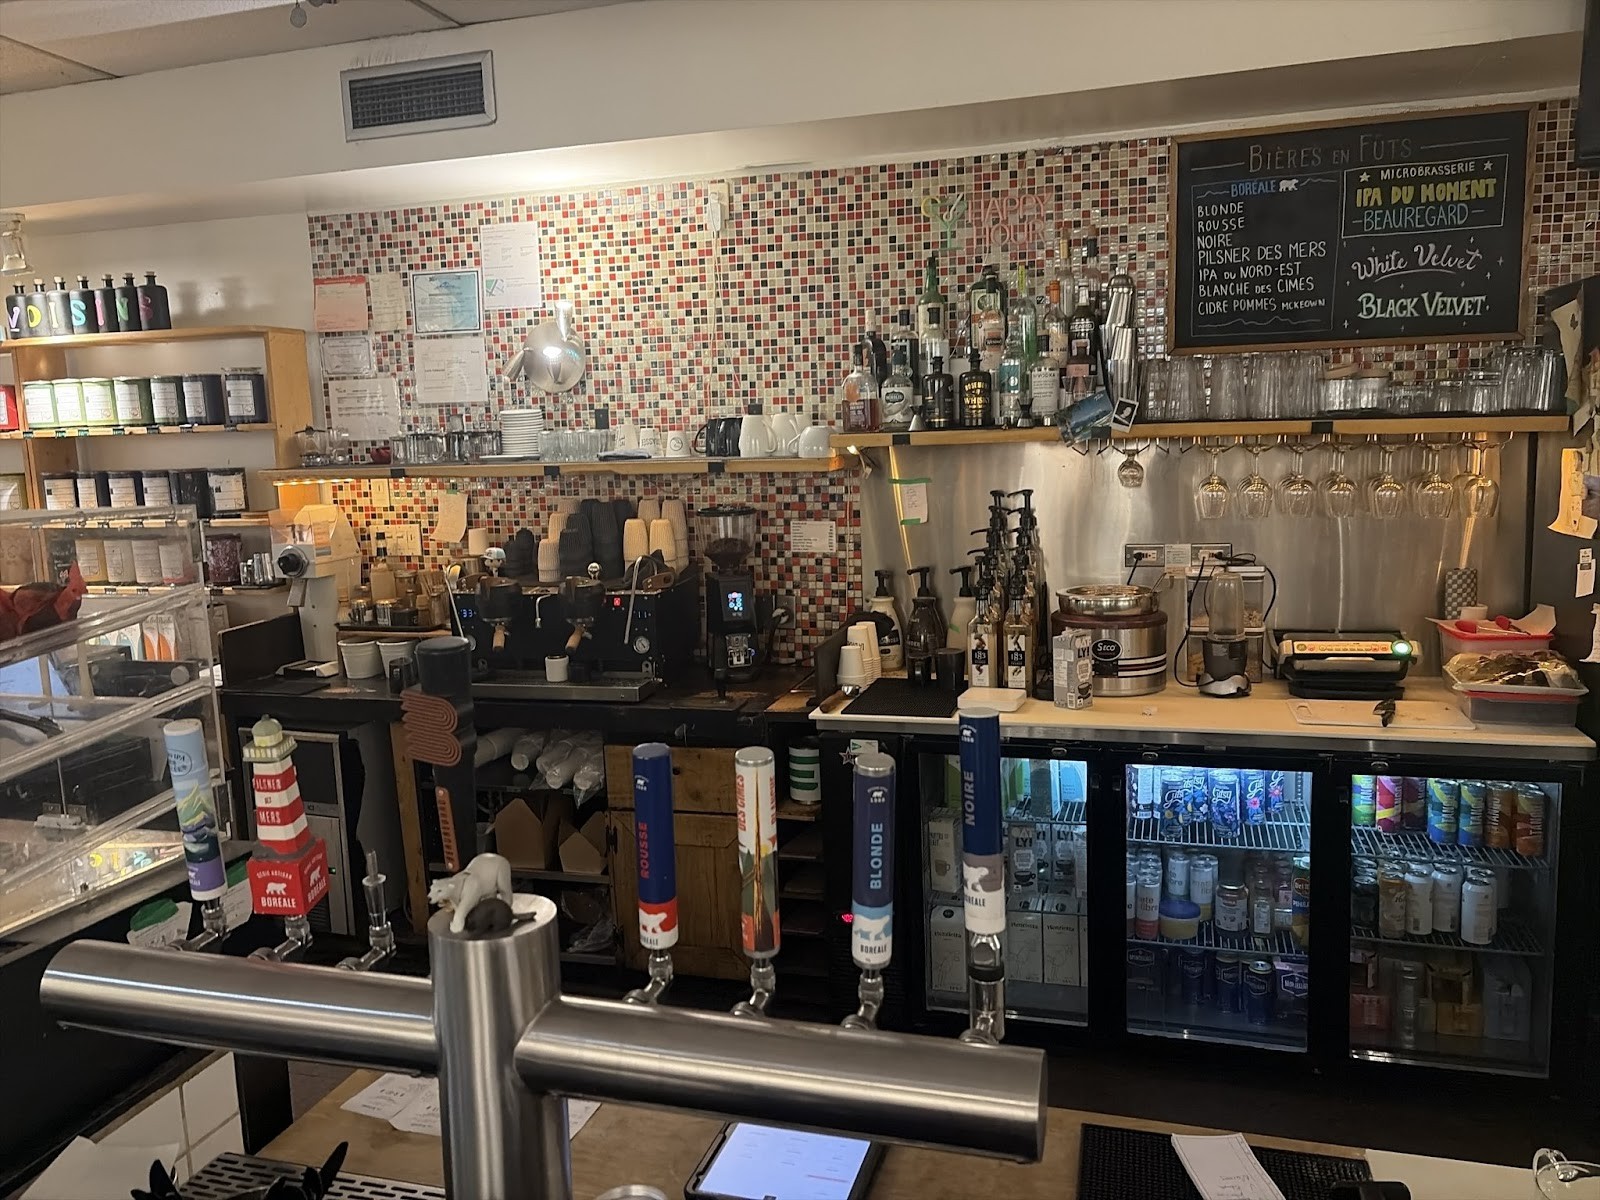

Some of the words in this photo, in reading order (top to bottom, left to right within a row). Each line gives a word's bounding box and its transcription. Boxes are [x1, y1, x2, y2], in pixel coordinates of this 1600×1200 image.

[1249, 144, 1322, 173] BIÈRES
[1332, 150, 1350, 164] EN
[1380, 161, 1476, 181] MICROBRASSERIE
[1356, 187, 1383, 208] IPA
[1390, 185, 1415, 206] DU
[1420, 177, 1498, 204] MOMENT
[968, 193, 1052, 223] HAPPY
[1197, 201, 1245, 218] BLONDE
[1363, 203, 1469, 232] BEAUREGARD
[973, 219, 1047, 250] HOUR
[1197, 216, 1245, 233] ROUSSE
[1197, 233, 1233, 250] NOIRE
[1198, 246, 1251, 266] PILSNER
[1257, 244, 1283, 261] DES
[1288, 241, 1327, 259] MERS
[1199, 268, 1218, 282] IPA
[1239, 261, 1302, 279] NORD-EST
[1351, 249, 1408, 280] White
[1413, 243, 1483, 271] Velvet
[1199, 281, 1250, 298] BLANCHE
[1255, 284, 1272, 294] DES
[1277, 276, 1315, 293] CIMES
[1198, 300, 1229, 316] CIDRE
[1233, 298, 1277, 312] POMMES
[1281, 298, 1326, 311] MCKEOWN
[963, 771, 976, 827] NOIRE
[259, 811, 282, 824] MERS
[639, 822, 650, 879] ROUSSE
[1015, 837, 1033, 848] LY!
[869, 822, 884, 890] BLONDE
